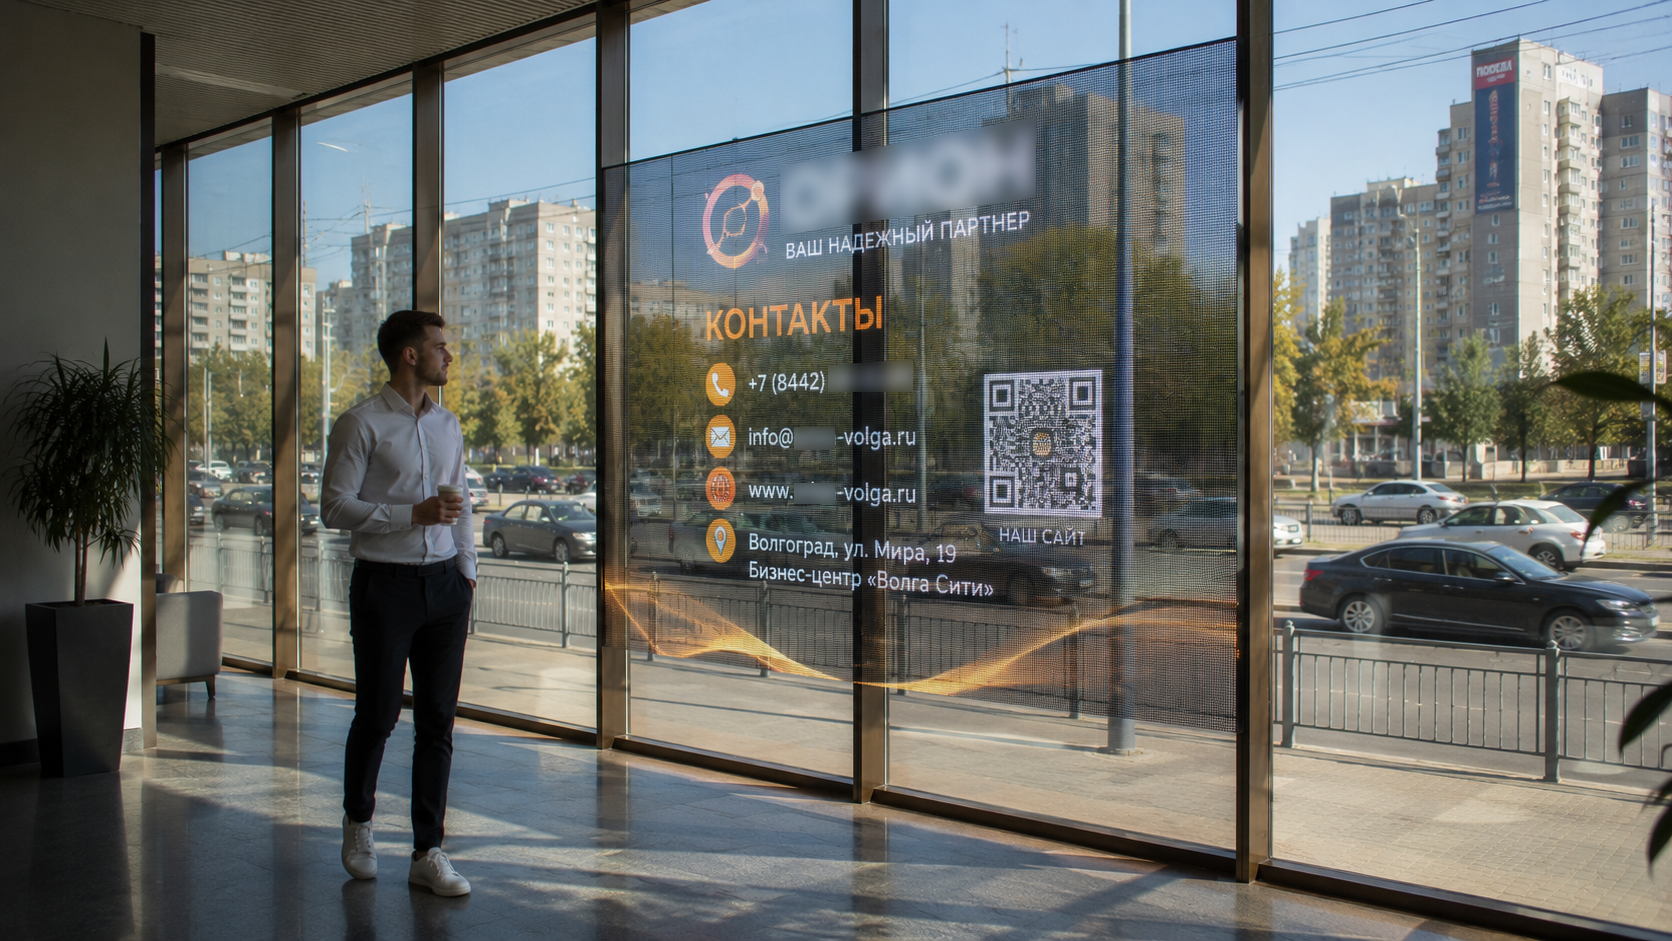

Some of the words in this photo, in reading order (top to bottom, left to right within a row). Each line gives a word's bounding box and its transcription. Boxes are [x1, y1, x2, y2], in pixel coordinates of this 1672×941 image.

[786, 239, 822, 260] ВАШ
[829, 219, 934, 254] НАДЕЖНЫЙ
[940, 210, 1030, 240] ПАРТНЕР
[706, 295, 883, 341] КОНТАКТЫ
[748, 374, 767, 392] +7
[771, 371, 826, 395] (8442)
[748, 425, 916, 451] info@-volga.ru
[748, 482, 916, 507] www.-volga.ru
[748, 532, 839, 559] Волгоград,
[843, 542, 868, 562] ул.
[874, 539, 931, 565] Мира,
[936, 544, 957, 564] 19
[999, 526, 1037, 543] НАШ
[1042, 525, 1086, 546] САЙТ
[748, 561, 862, 591] Бизнес-центр
[867, 570, 929, 593] «Волга
[935, 573, 994, 597] Сити»
